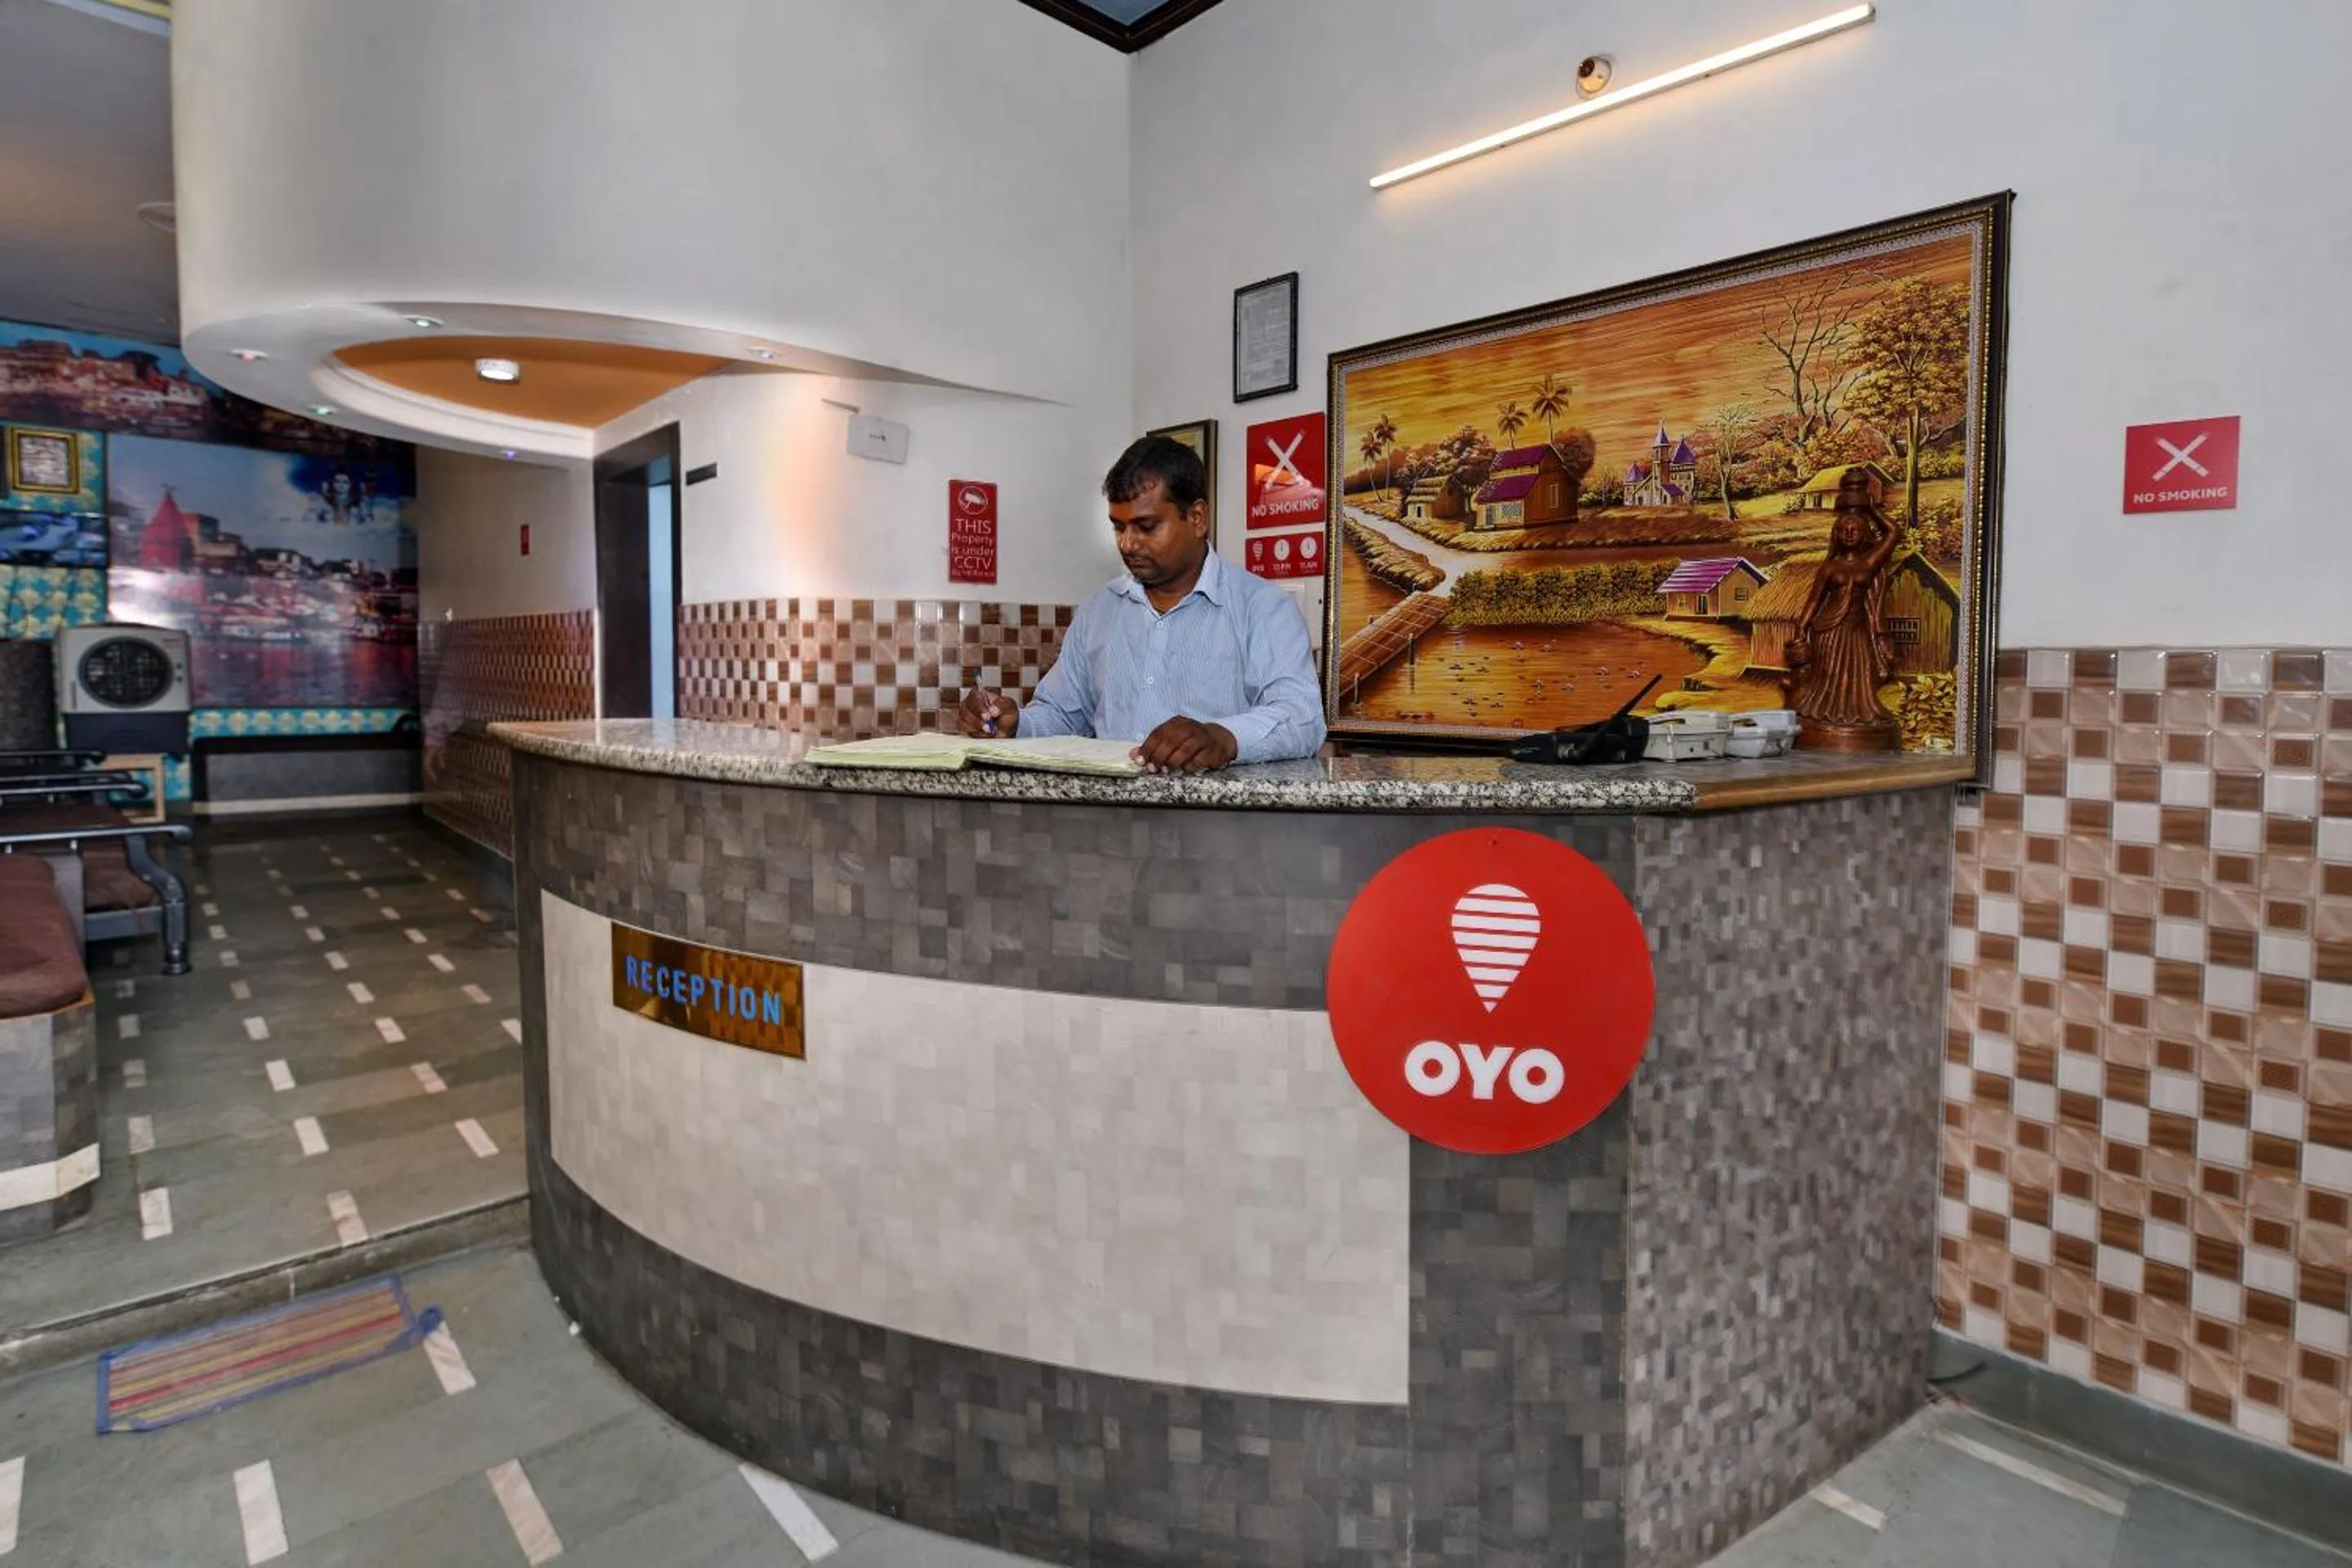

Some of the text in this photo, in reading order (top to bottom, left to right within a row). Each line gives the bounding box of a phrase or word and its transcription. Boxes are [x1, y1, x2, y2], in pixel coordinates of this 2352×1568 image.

[2133, 487, 2228, 504] NO SMOKING
[1252, 498, 1319, 517] NO SMOKING
[955, 518, 991, 534] THIS
[962, 545, 994, 556] under
[954, 556, 991, 570] CCTV
[626, 955, 782, 1026] RECEPTION
[1404, 1040, 1565, 1104] OYO
